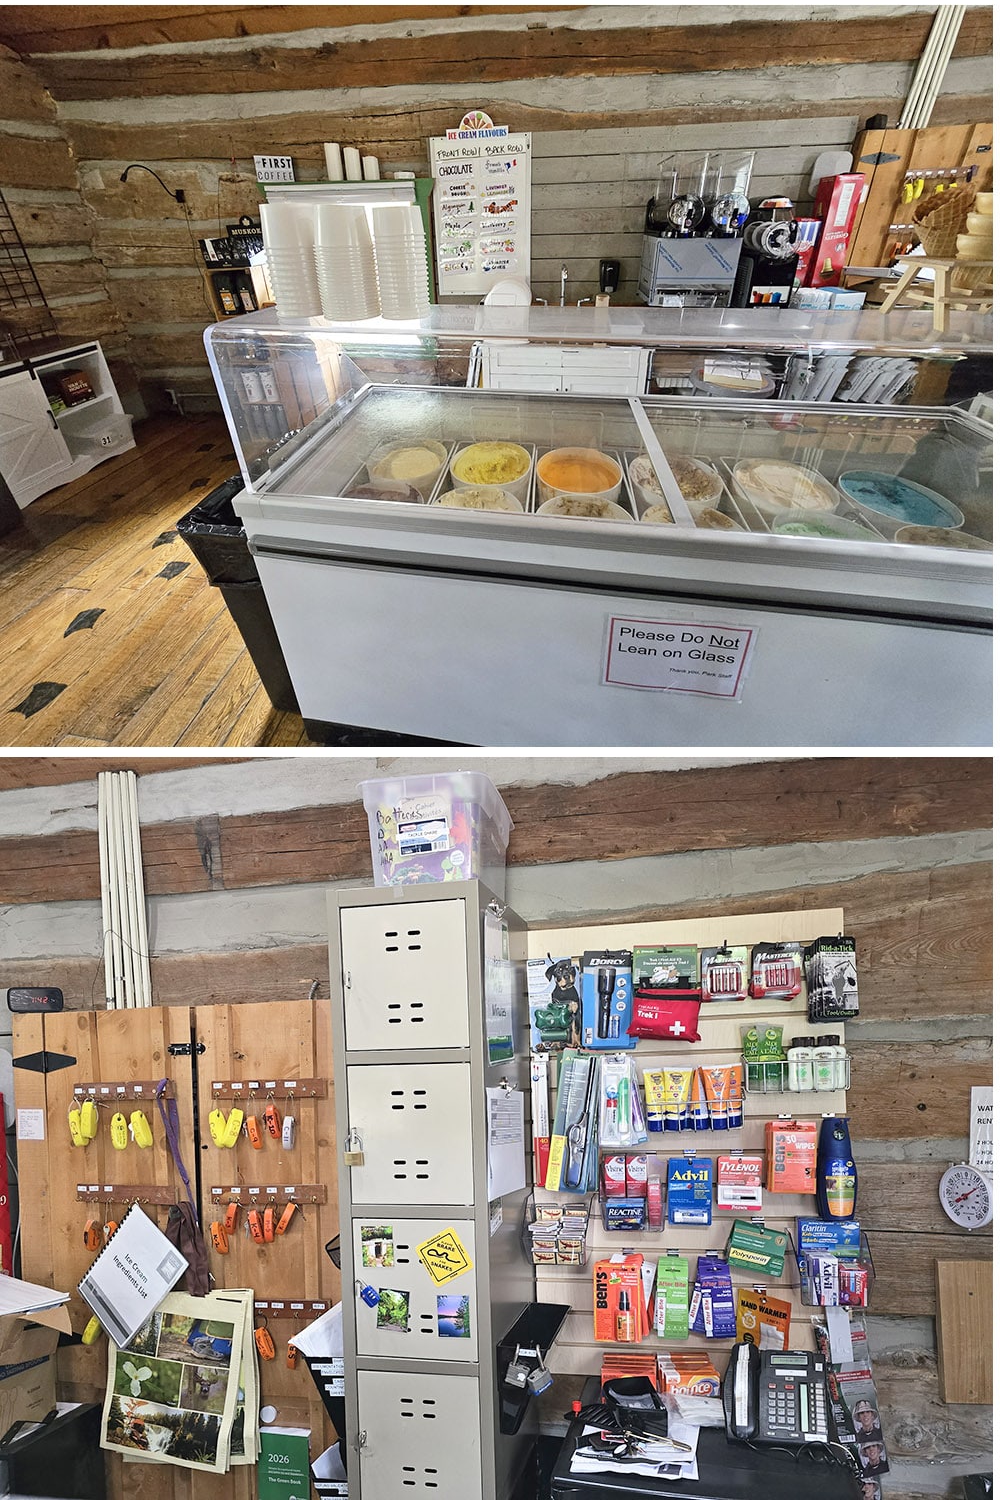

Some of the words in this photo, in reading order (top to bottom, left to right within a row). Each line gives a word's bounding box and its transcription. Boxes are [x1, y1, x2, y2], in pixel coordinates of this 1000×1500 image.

[448, 132, 457, 140] ICE
[458, 130, 477, 139] CREAM
[478, 128, 507, 138] FLAVOURS
[437, 148, 460, 159] FRONT
[507, 144, 524, 152] ROW
[262, 158, 292, 169] FIRST
[258, 170, 294, 181] COFFEE
[438, 164, 472, 176] CHOCOLATE
[231, 228, 262, 236] MUSKOK
[102, 436, 112, 446] 31
[620, 627, 675, 642] Please
[680, 632, 704, 644] Do
[709, 634, 740, 648] Not
[618, 642, 656, 656] Lean
[662, 649, 682, 658] on
[688, 650, 736, 664] Glass
[702, 670, 716, 678] Park
[820, 944, 854, 952] Rid-a-Tick
[589, 958, 626, 966] DORCY
[705, 956, 746, 965] MASTERCELL
[756, 953, 798, 962] MASTERCELL
[637, 1010, 654, 1018] Trek
[786, 1136, 797, 1146] 30
[795, 1142, 816, 1150] WIPES
[605, 1164, 624, 1173] Visine
[720, 1162, 762, 1173] TYLENOL
[671, 1170, 709, 1184] Advil
[608, 1207, 643, 1217] REACTINE
[802, 1224, 827, 1233] Claritin
[730, 1250, 770, 1265] Polysporin
[124, 1254, 134, 1264] Ice
[132, 1262, 148, 1284] Cream
[113, 1255, 138, 1290] Ingredients
[138, 1286, 148, 1300] List
[741, 1300, 756, 1311] HAND
[757, 1304, 788, 1320] WARMER
[671, 1382, 712, 1396] bounce
[268, 1453, 290, 1463] 2026
[268, 1476, 276, 1484] The
[278, 1476, 291, 1484] Green
[292, 1476, 304, 1484] Book
